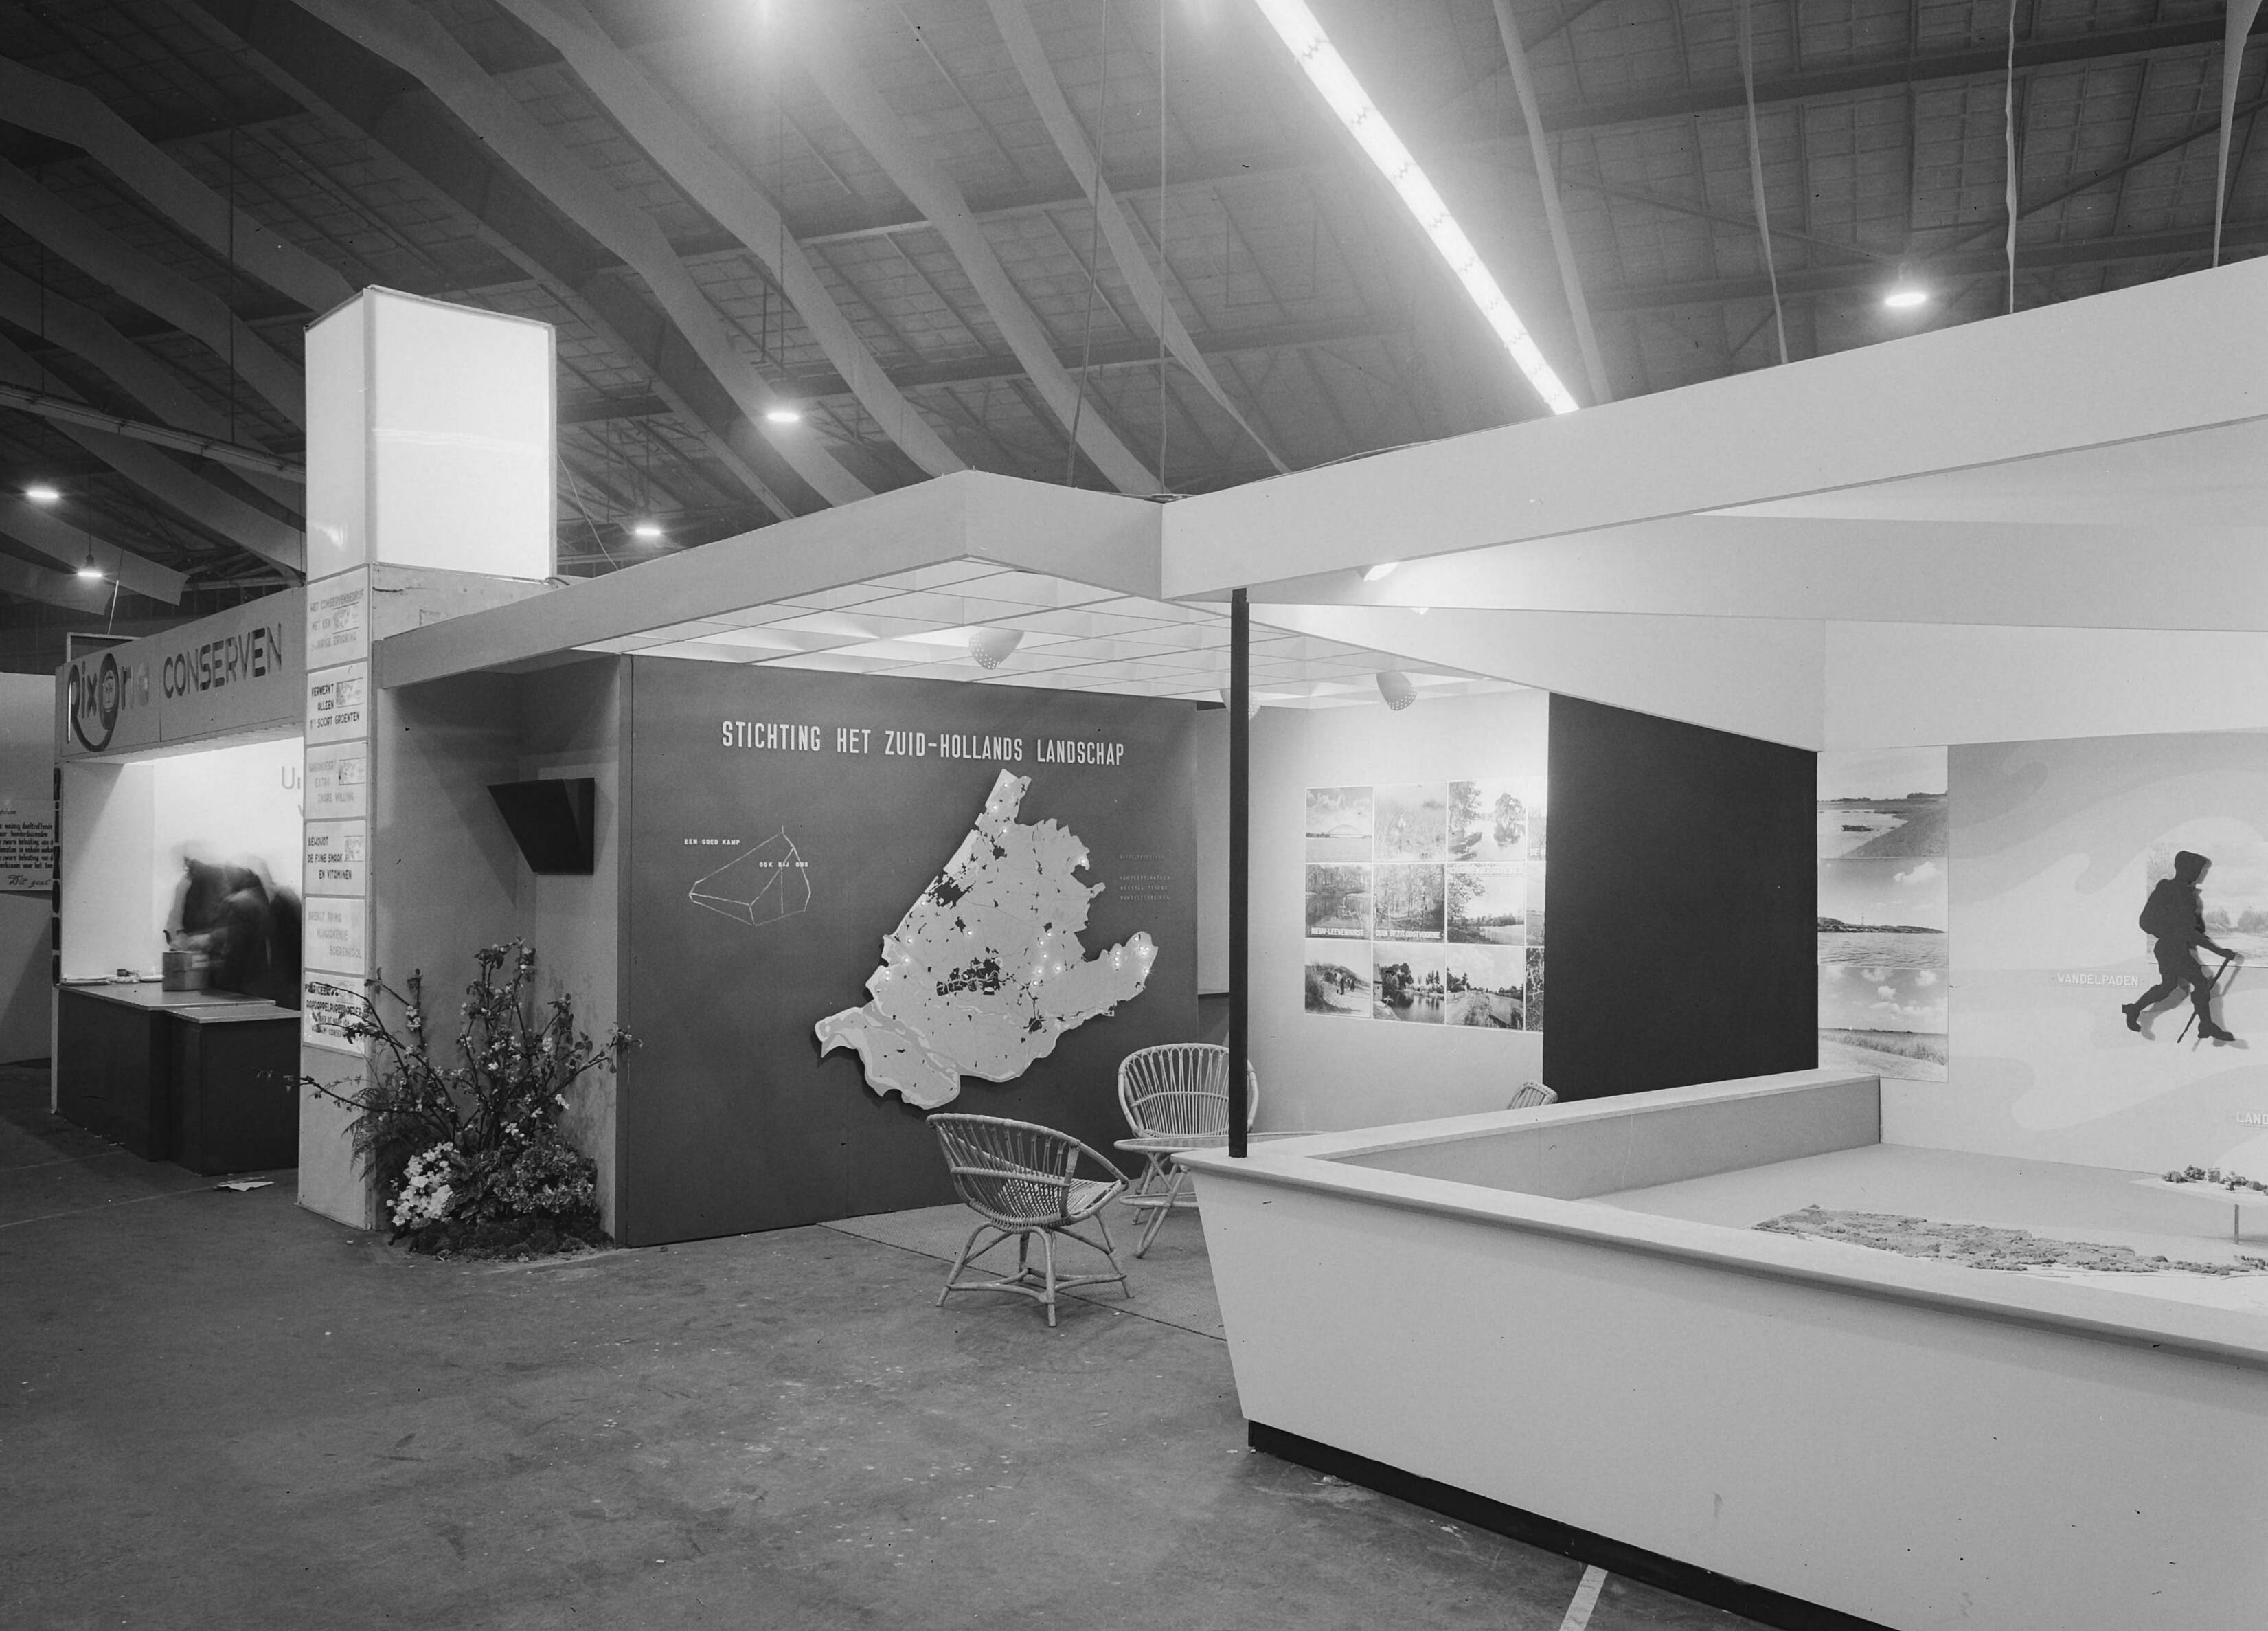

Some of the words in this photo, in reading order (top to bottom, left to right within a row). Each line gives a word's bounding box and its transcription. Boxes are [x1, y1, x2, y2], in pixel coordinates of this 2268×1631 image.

[163, 622, 282, 699] CONSERVEN
[312, 684, 334, 697] VERWERKT
[318, 700, 334, 711] ALLEEN
[317, 716, 332, 728] SOORT
[335, 712, 359, 725] GROENTEN
[722, 720, 821, 751] STICHTING
[837, 728, 871, 754] HET
[885, 730, 1023, 761] ZUID-HOLLANDS
[1037, 739, 1124, 766] LANDSCHAP
[308, 853, 314, 863] DE
[328, 853, 343, 863] SMAAK
[319, 869, 326, 879] EN
[327, 869, 352, 879] VITAMINEN
[2057, 972, 2139, 986] WANDELPADEN
